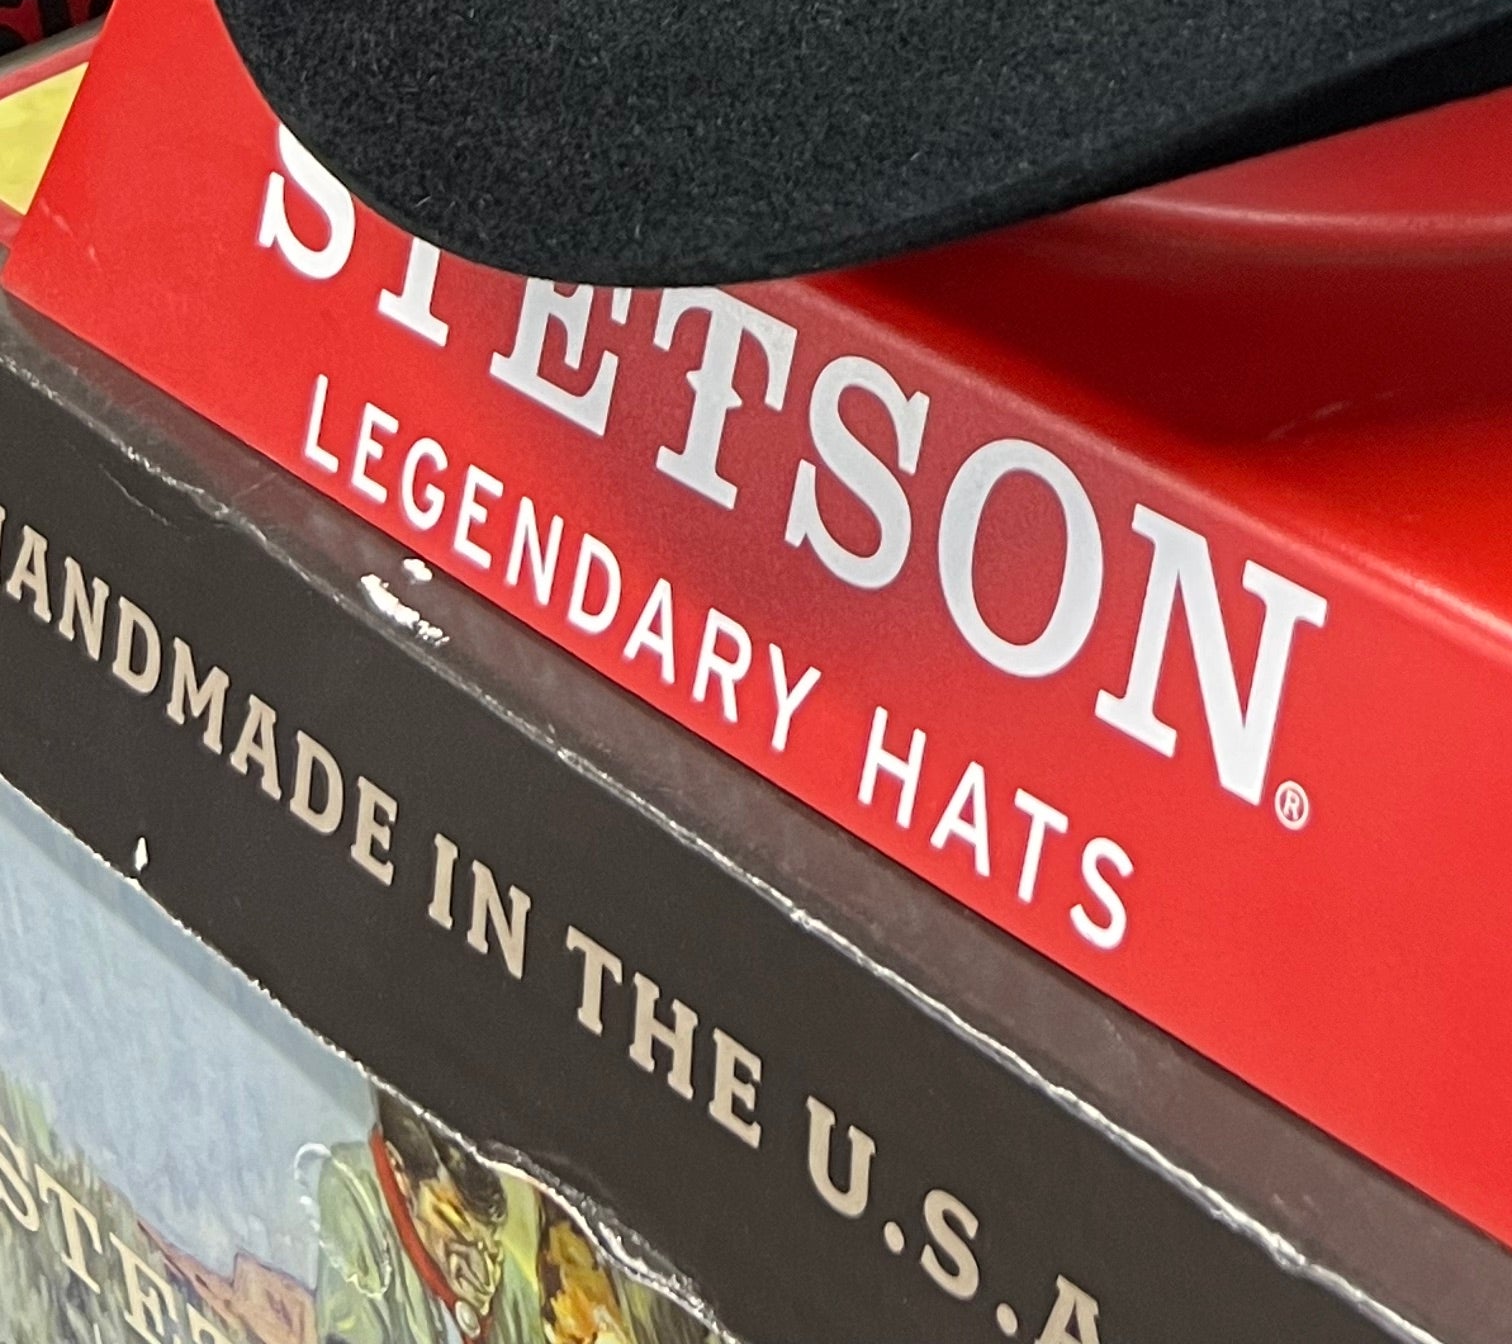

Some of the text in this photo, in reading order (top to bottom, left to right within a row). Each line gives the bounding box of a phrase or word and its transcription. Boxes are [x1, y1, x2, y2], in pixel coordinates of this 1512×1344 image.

[0, 505, 399, 887] ANDMADE
[427, 832, 533, 980] IN
[565, 924, 765, 1150] THE
[303, 373, 1135, 950] LEGENDARY HATS
